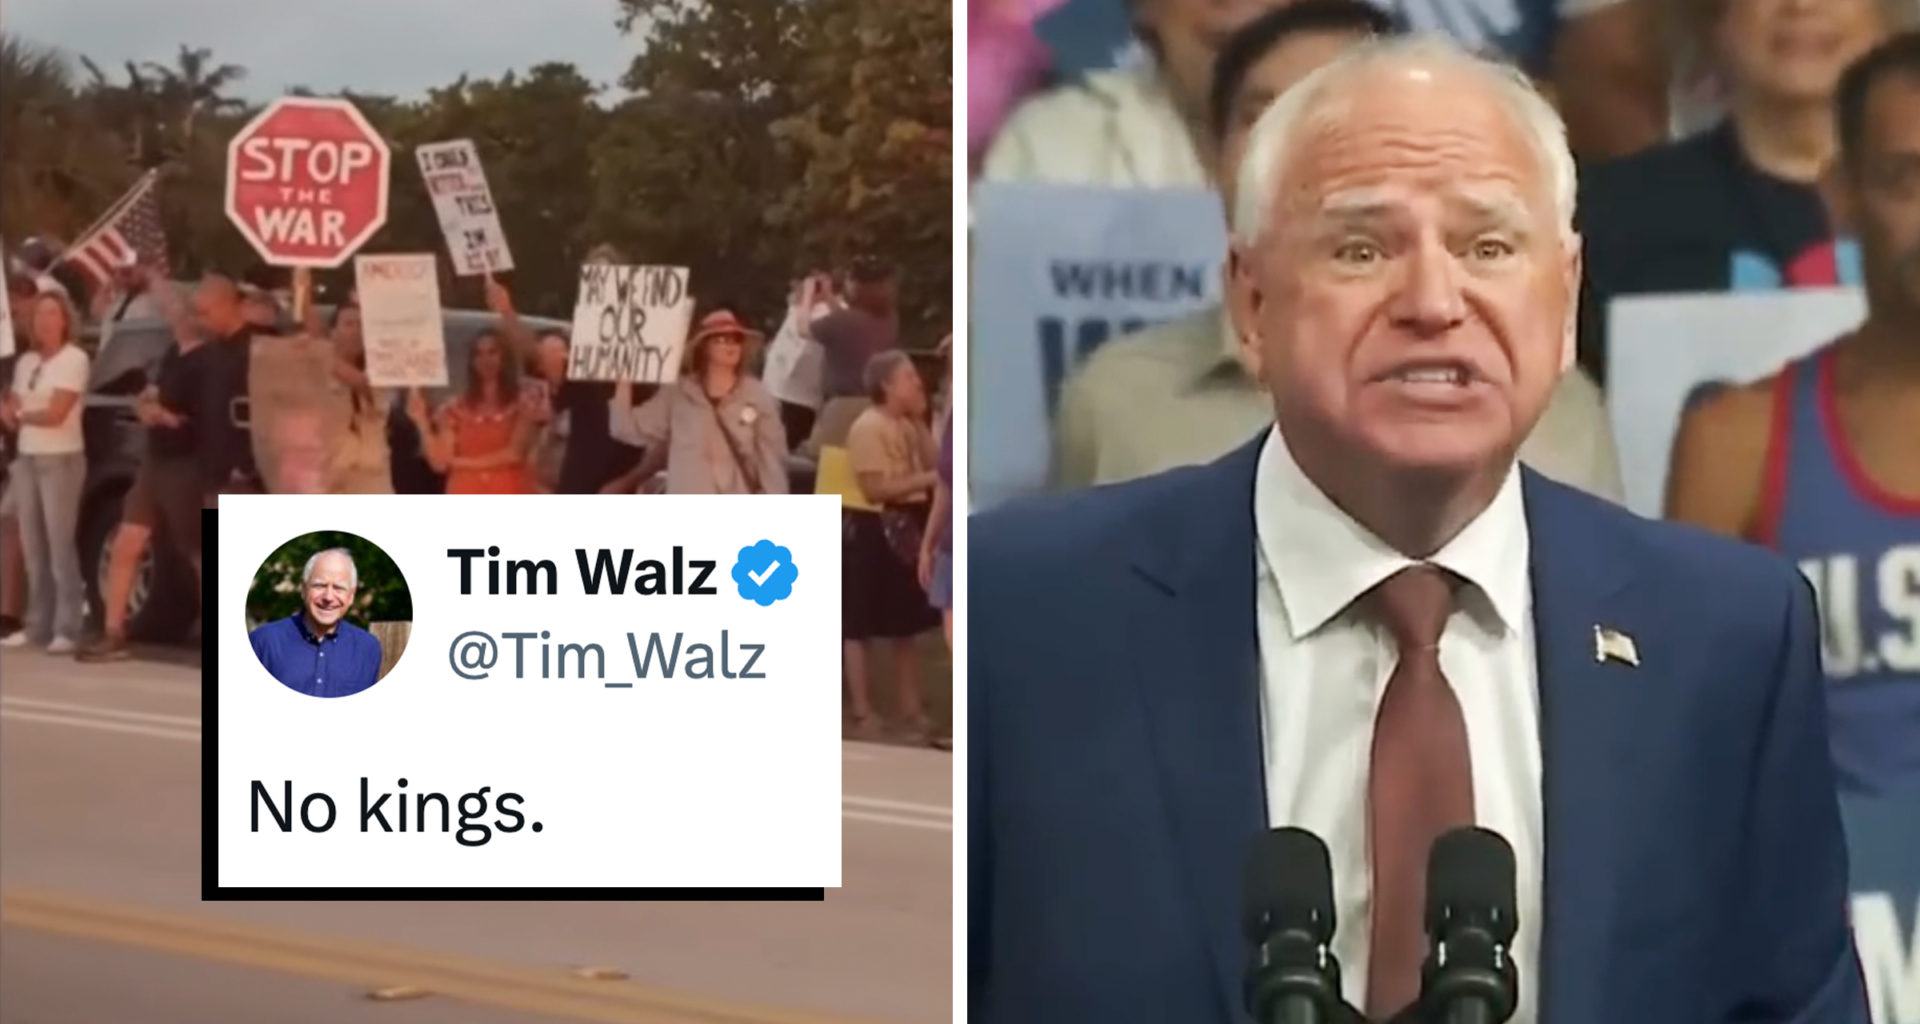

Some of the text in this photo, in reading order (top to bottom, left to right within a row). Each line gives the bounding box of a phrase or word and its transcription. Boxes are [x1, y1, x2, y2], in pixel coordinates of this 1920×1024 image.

[241, 136, 373, 185] STOP
[279, 187, 333, 205] THE
[253, 205, 347, 248] WAR
[580, 264, 683, 309] MAY WE FIND
[1050, 261, 1205, 299] WHEN
[598, 303, 647, 347] OUR
[571, 344, 673, 380] HUMANITY
